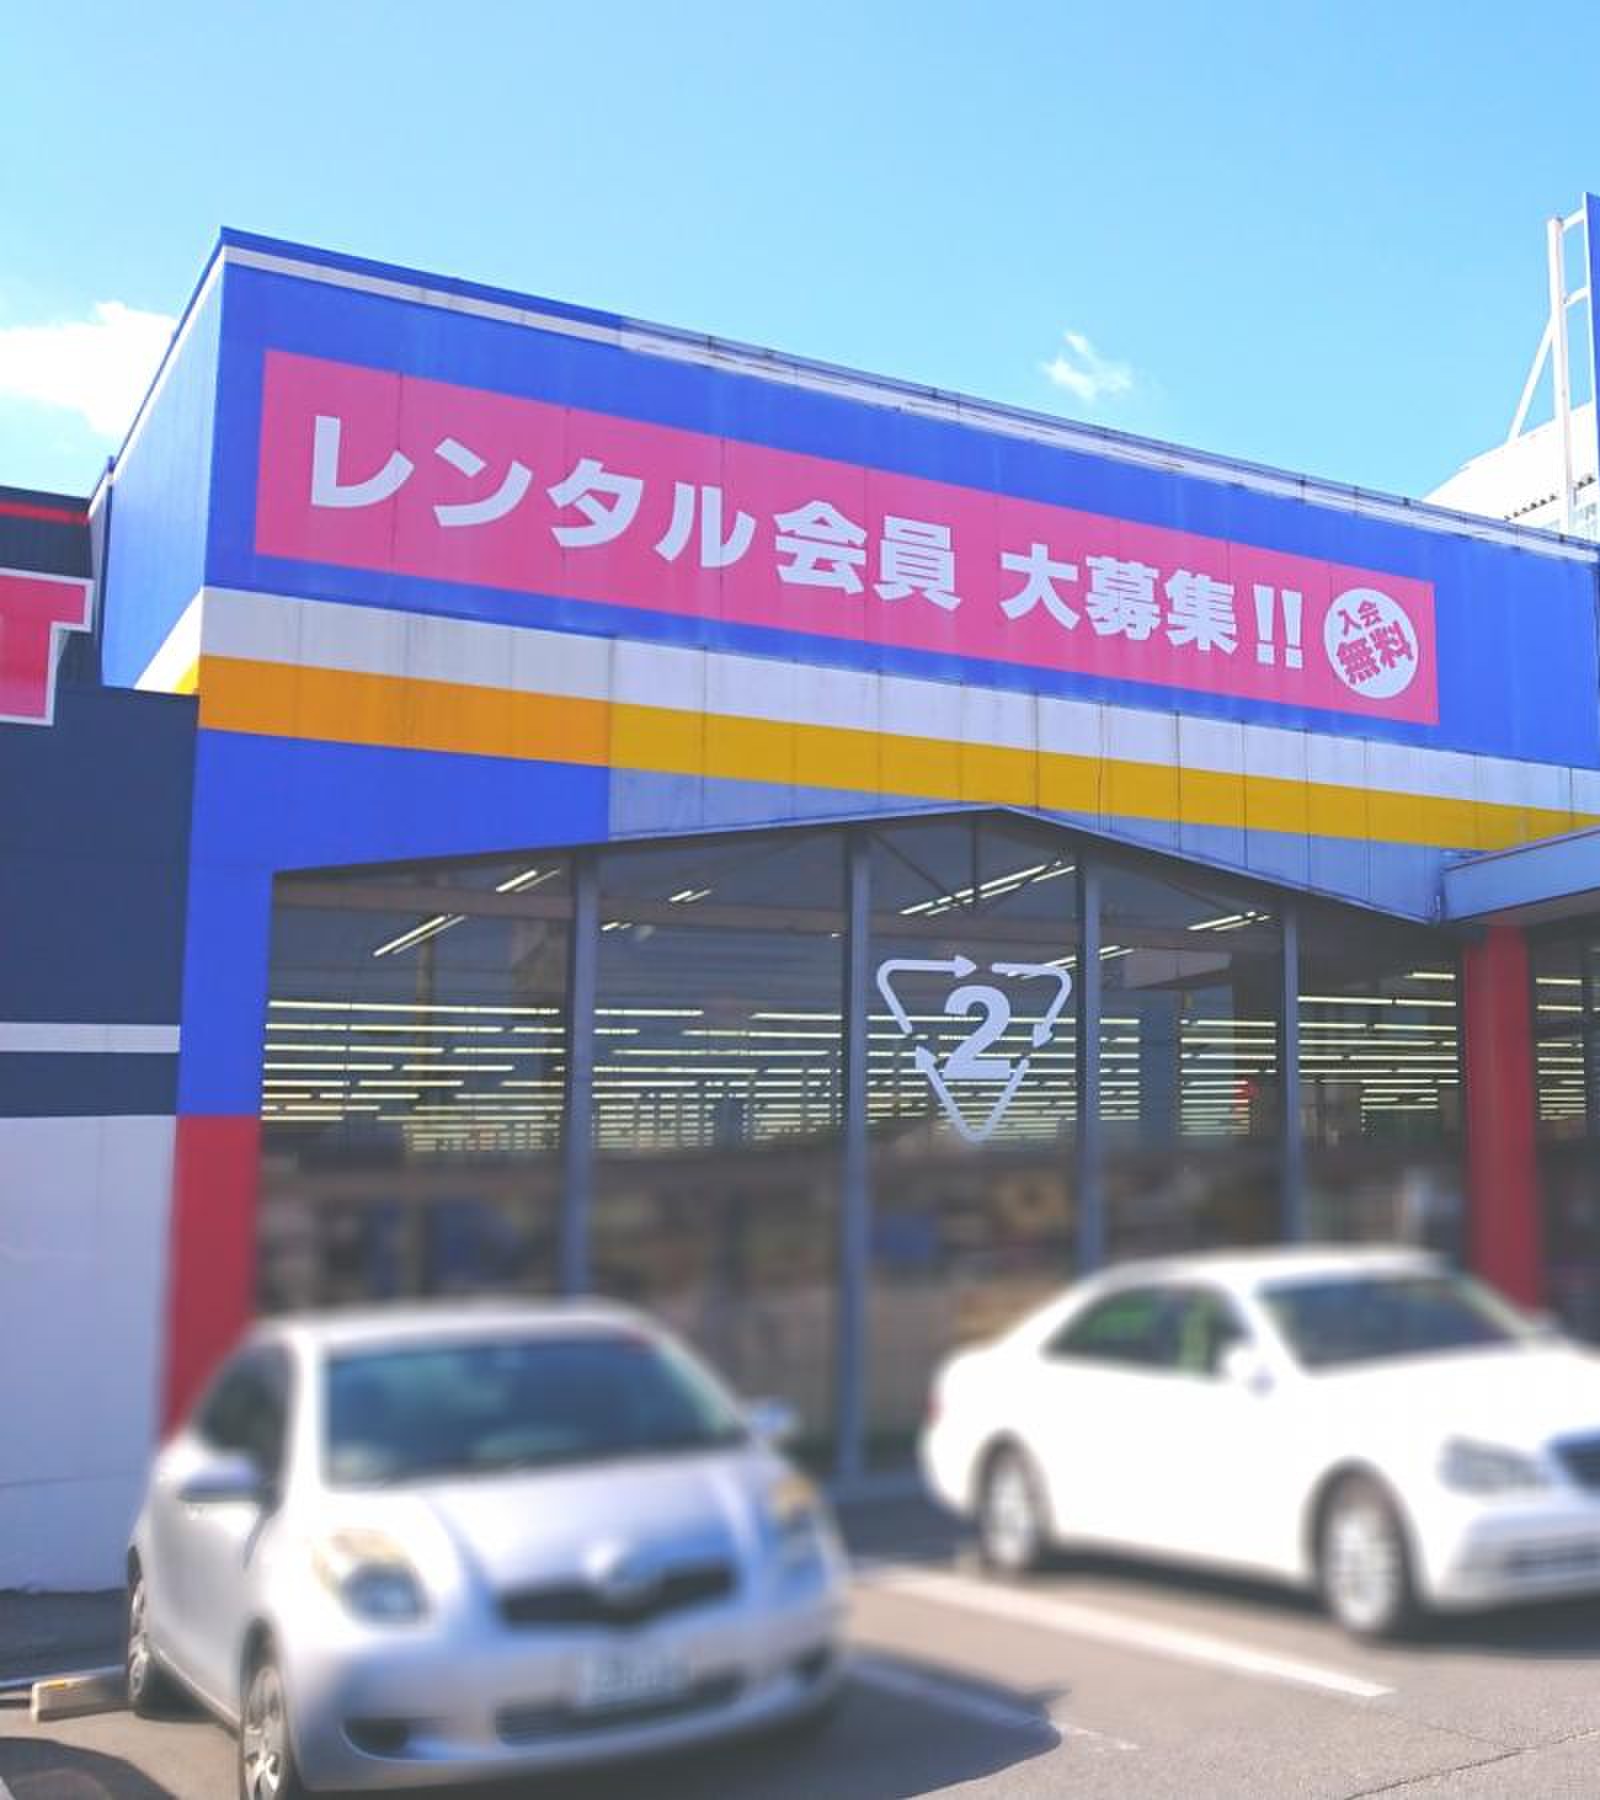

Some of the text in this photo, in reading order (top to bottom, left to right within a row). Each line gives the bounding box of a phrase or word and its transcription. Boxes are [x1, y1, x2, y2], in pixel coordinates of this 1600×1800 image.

[310, 414, 961, 611] レンタル会員
[1337, 600, 1382, 636] 入会
[1336, 620, 1414, 684] 無料
